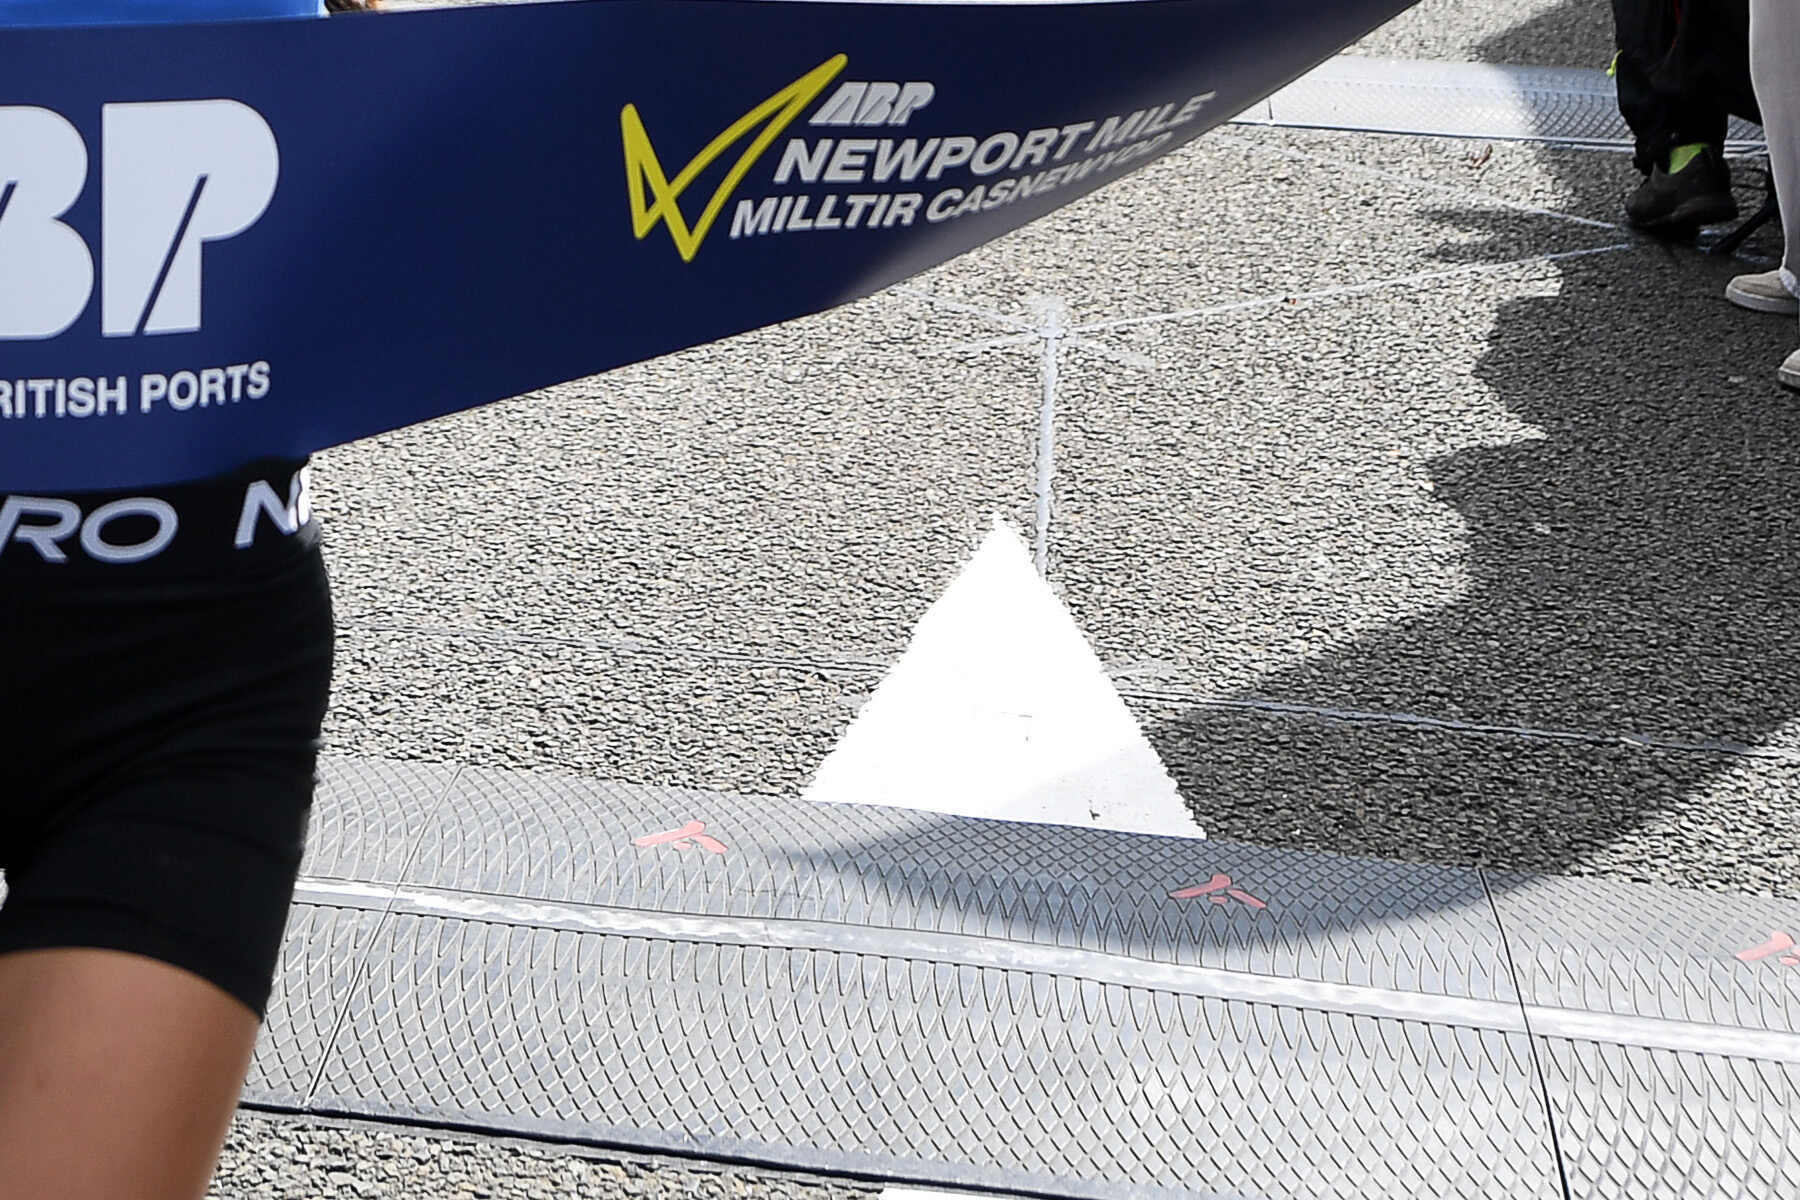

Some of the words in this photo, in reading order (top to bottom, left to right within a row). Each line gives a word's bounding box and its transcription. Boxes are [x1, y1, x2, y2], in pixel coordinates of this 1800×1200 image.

[773, 120, 1097, 184] NEWPORT
[1085, 90, 1217, 154] MILE
[808, 81, 936, 126] ABP
[729, 192, 924, 240] MILLTIR
[926, 131, 1174, 224] CASNEWYDD
[140, 361, 271, 413] PORTS
